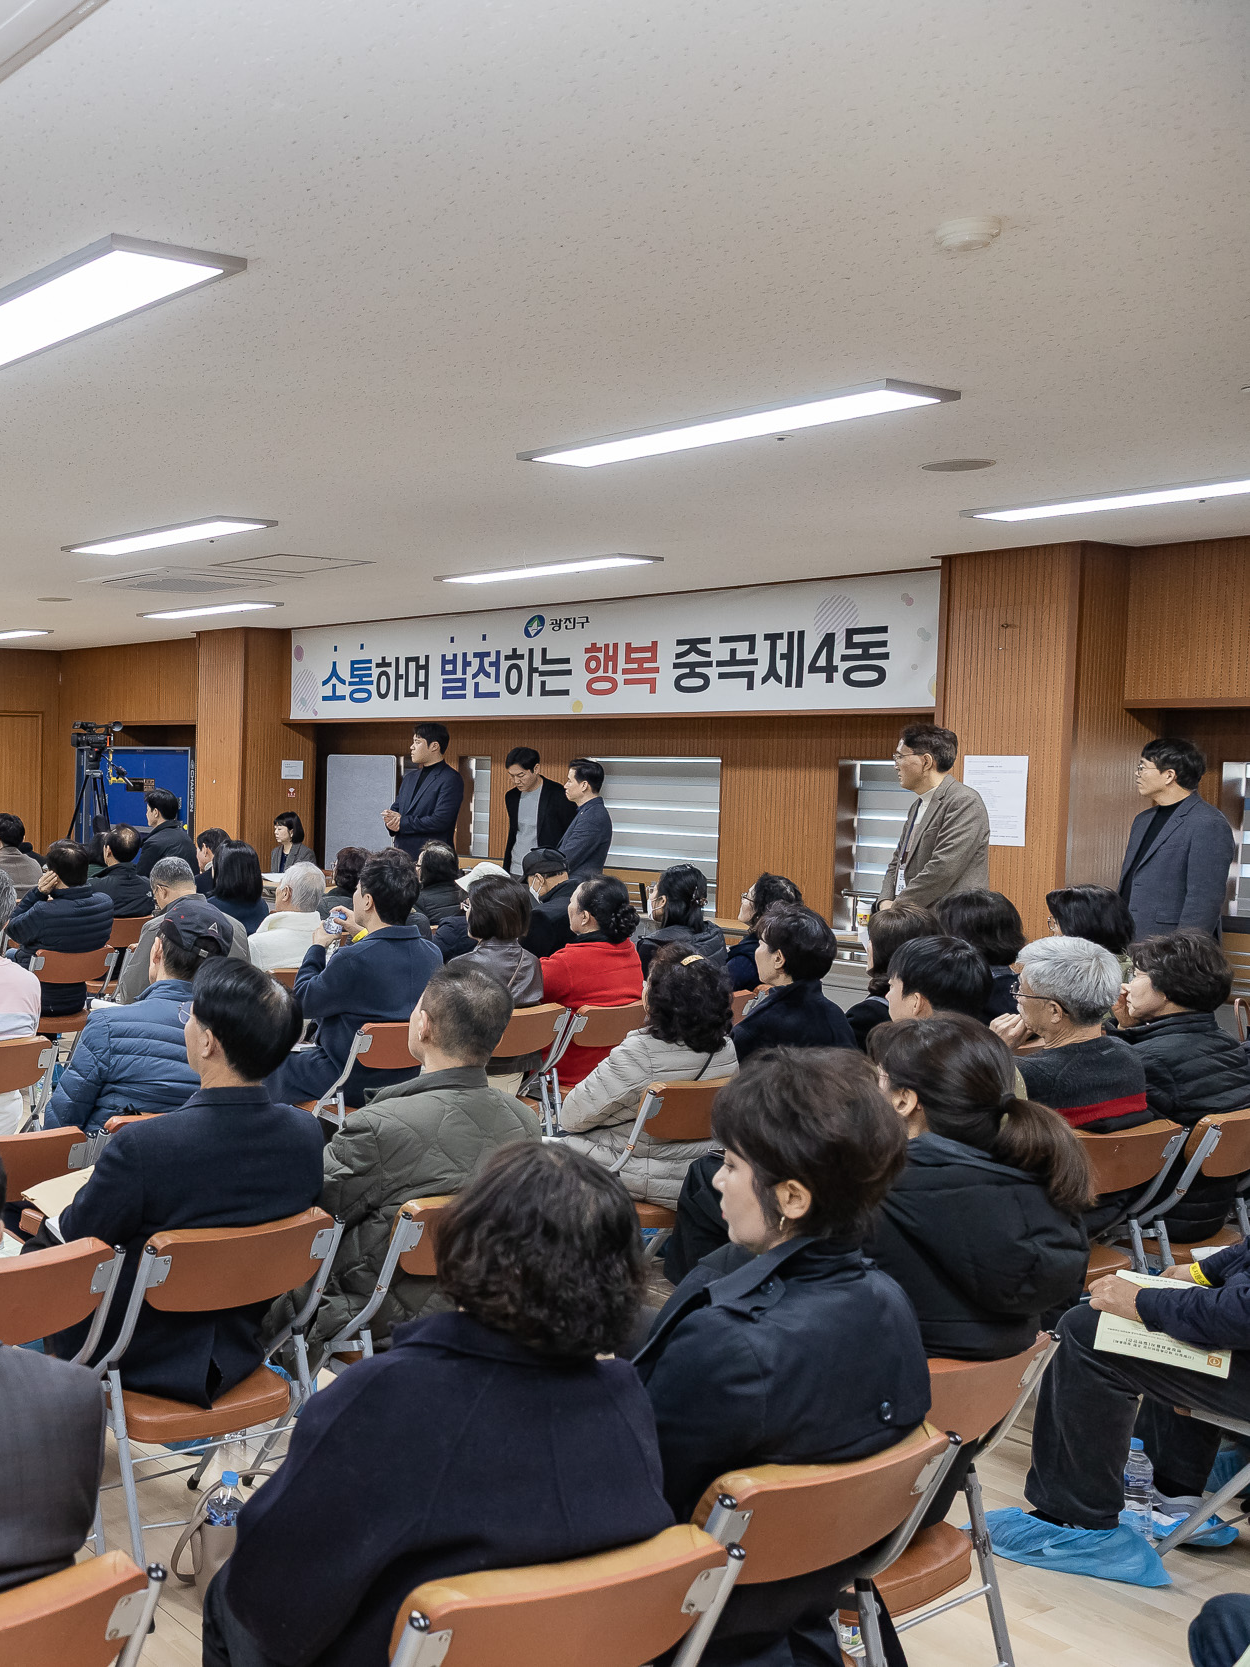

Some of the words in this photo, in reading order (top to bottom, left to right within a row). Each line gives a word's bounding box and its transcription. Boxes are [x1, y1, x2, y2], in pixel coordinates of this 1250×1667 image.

[549, 616, 590, 631] 광진구
[321, 655, 430, 703] 소통하며
[440, 647, 573, 700] 발전하는
[584, 640, 660, 696] 행복
[672, 625, 890, 694] 중곡제4동
